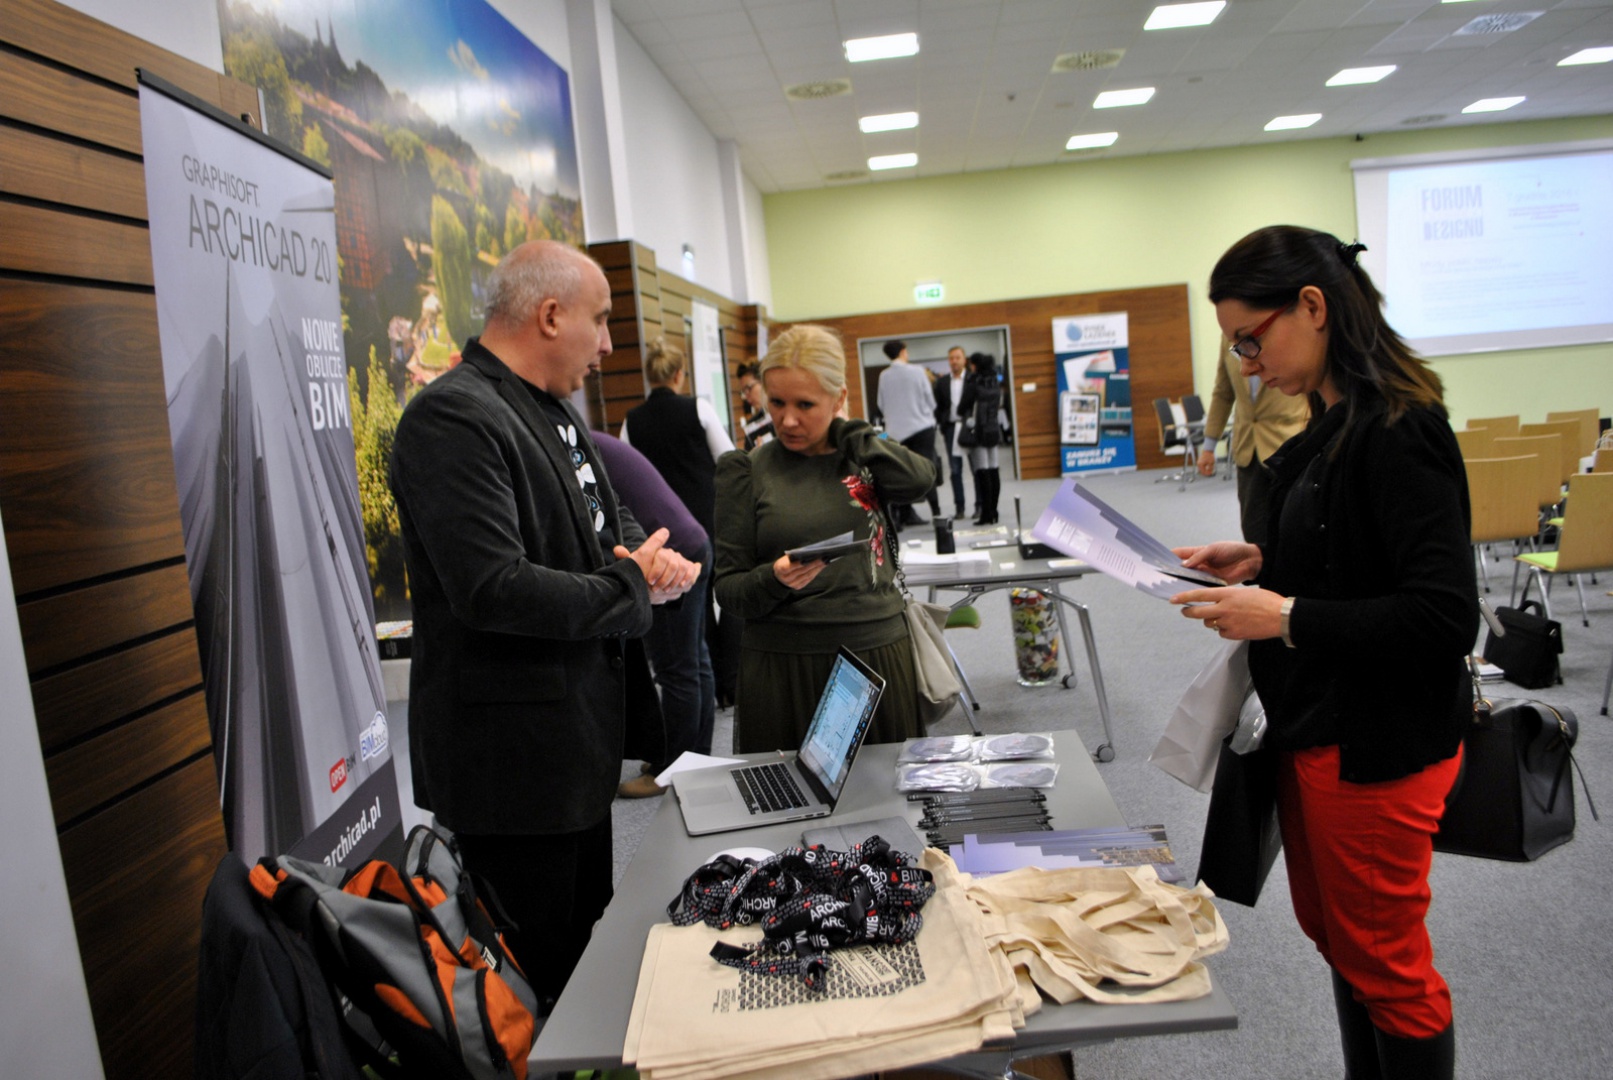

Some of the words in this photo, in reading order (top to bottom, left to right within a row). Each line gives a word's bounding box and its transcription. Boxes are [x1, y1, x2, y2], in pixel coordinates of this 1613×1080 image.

[182, 154, 259, 207] GRAPHISOFT
[1421, 184, 1482, 212] FORUM
[189, 194, 307, 277] ARCHICAD
[311, 237, 331, 284] 20
[302, 317, 340, 352] NOWE
[306, 354, 343, 378] OBLICZE
[309, 382, 349, 430] BIM
[323, 796, 381, 868] archicad.pl
[901, 869, 924, 882] BIM
[742, 896, 777, 910] ARCHI
